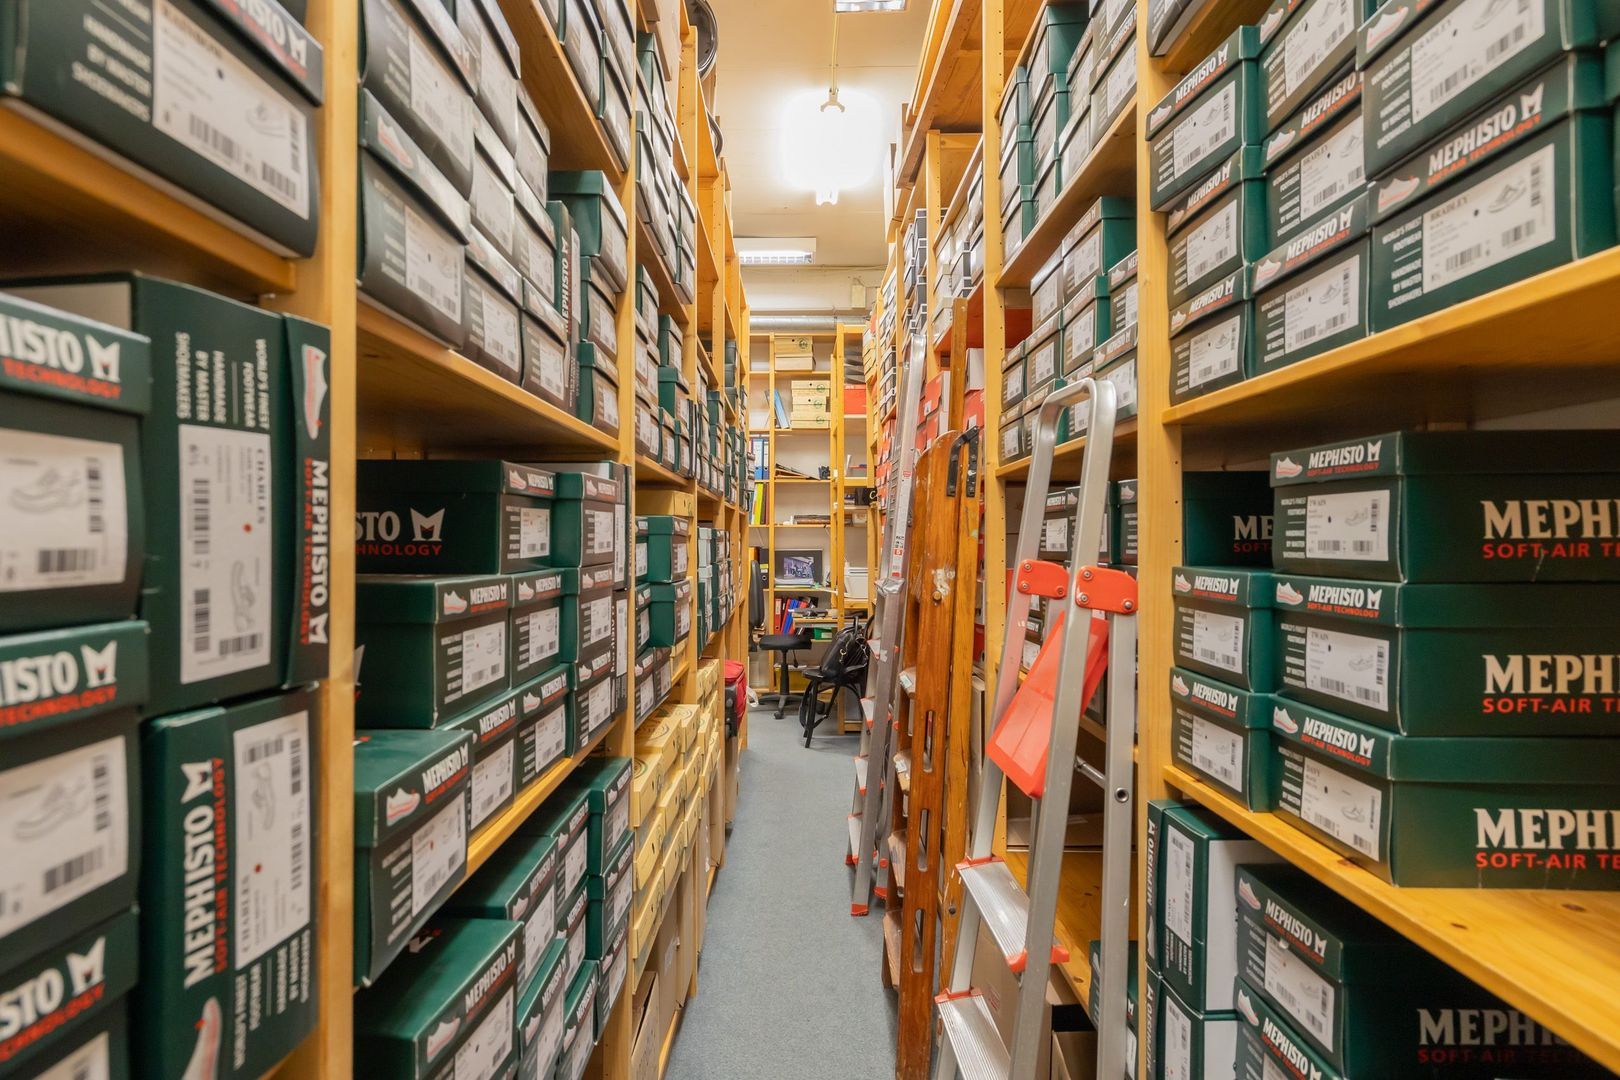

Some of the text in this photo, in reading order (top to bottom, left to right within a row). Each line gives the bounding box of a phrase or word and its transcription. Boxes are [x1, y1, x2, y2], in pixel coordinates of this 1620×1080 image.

[1175, 57, 1217, 104] MEPHISTO
[1301, 71, 1356, 128] MEPHISTO
[1428, 105, 1516, 176] MEPHISTO
[1187, 171, 1221, 210] MEPHISTO
[1286, 218, 1338, 262] MEPHISTO
[1189, 284, 1224, 315] MEPHISTO
[1308, 445, 1364, 469] MEPHISTO
[310, 460, 328, 607] MEPHISTO
[1482, 543, 1590, 559] SOFT-AIR
[1194, 576, 1228, 594] MEPHISTO
[1308, 584, 1364, 608] MEPHISTO
[1482, 654, 1620, 694] MEPH
[1192, 682, 1228, 708] MEPHISTO
[1482, 698, 1590, 714] SOFT-AIR
[1303, 717, 1358, 752] MEPHISTO
[422, 750, 461, 794] MEPHISTO
[1476, 852, 1586, 869] SOFT-AIR
[184, 804, 216, 990] MEPHISTO
[1265, 899, 1312, 946] MEPHISTO
[466, 957, 508, 1014] MEPHISTO
[1263, 1017, 1308, 1074] MEPHISTO
[1417, 1008, 1572, 1046] MEPHI
